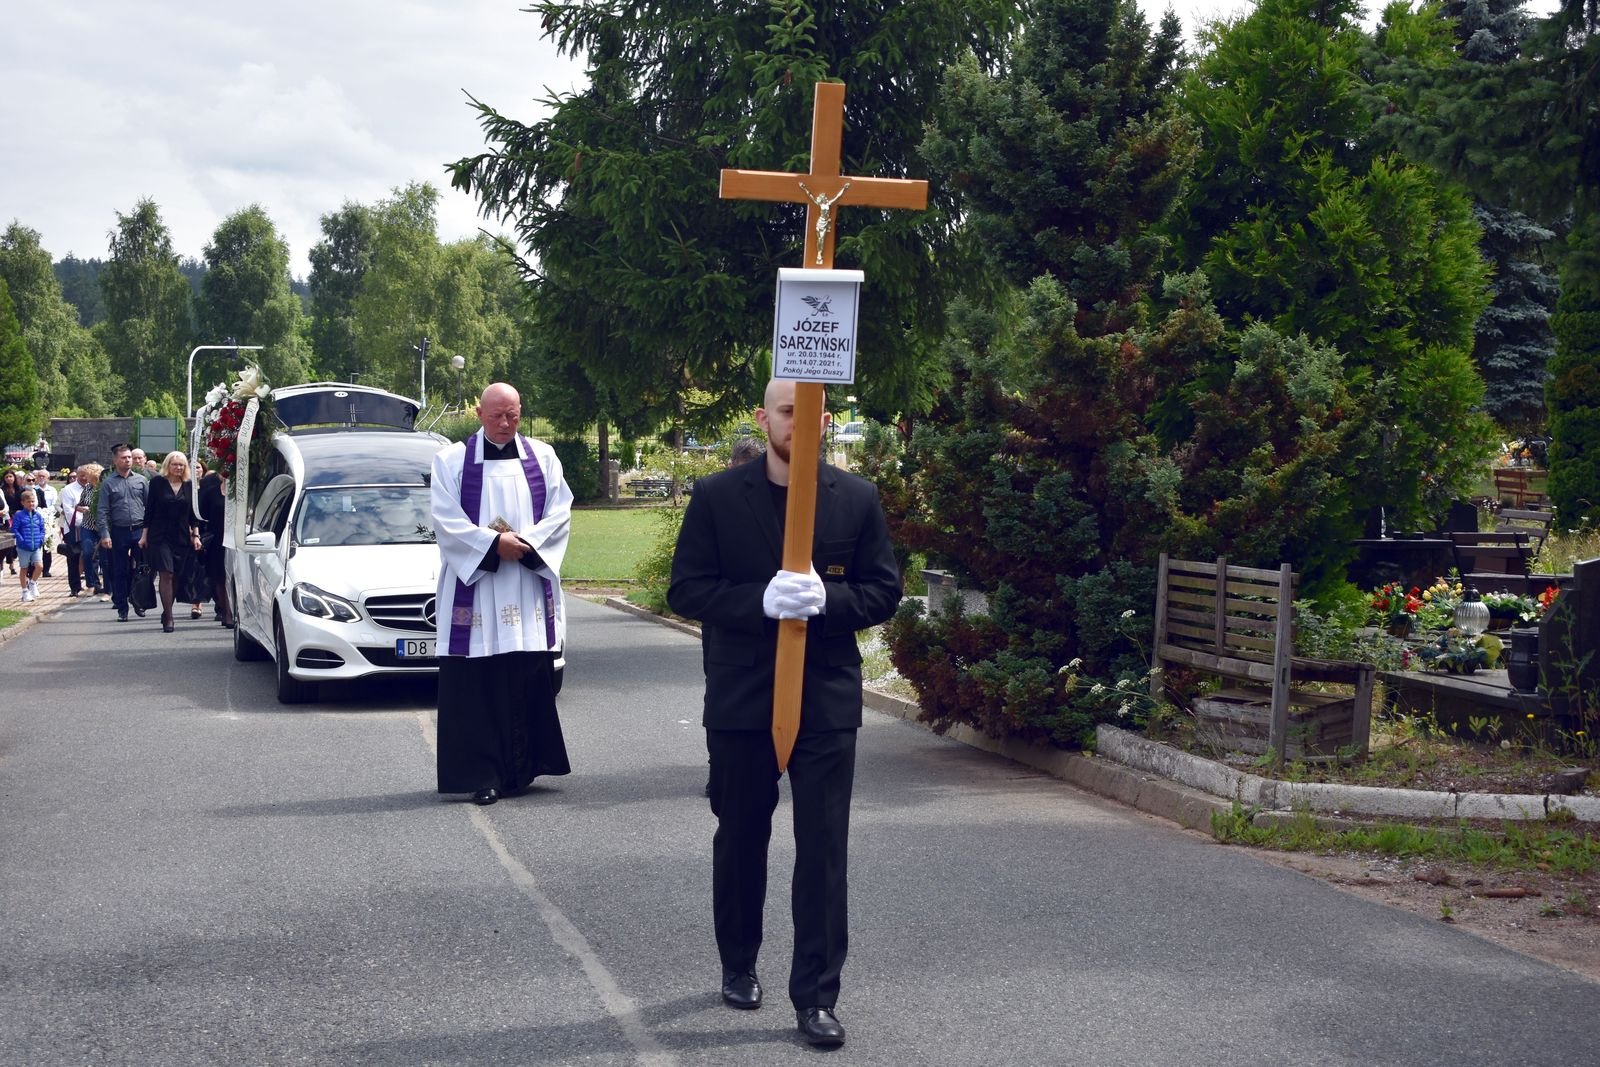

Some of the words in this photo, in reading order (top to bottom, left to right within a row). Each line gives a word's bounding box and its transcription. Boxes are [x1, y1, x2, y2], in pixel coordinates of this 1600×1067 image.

[793, 317, 839, 333] JÓZEF
[780, 334, 850, 352] SARZYŃSKI
[798, 351, 835, 359] 20.03.1944
[782, 366, 803, 375] Pokój
[804, 366, 821, 375] Jego
[822, 368, 844, 377] Duszy
[407, 641, 427, 655] D8
